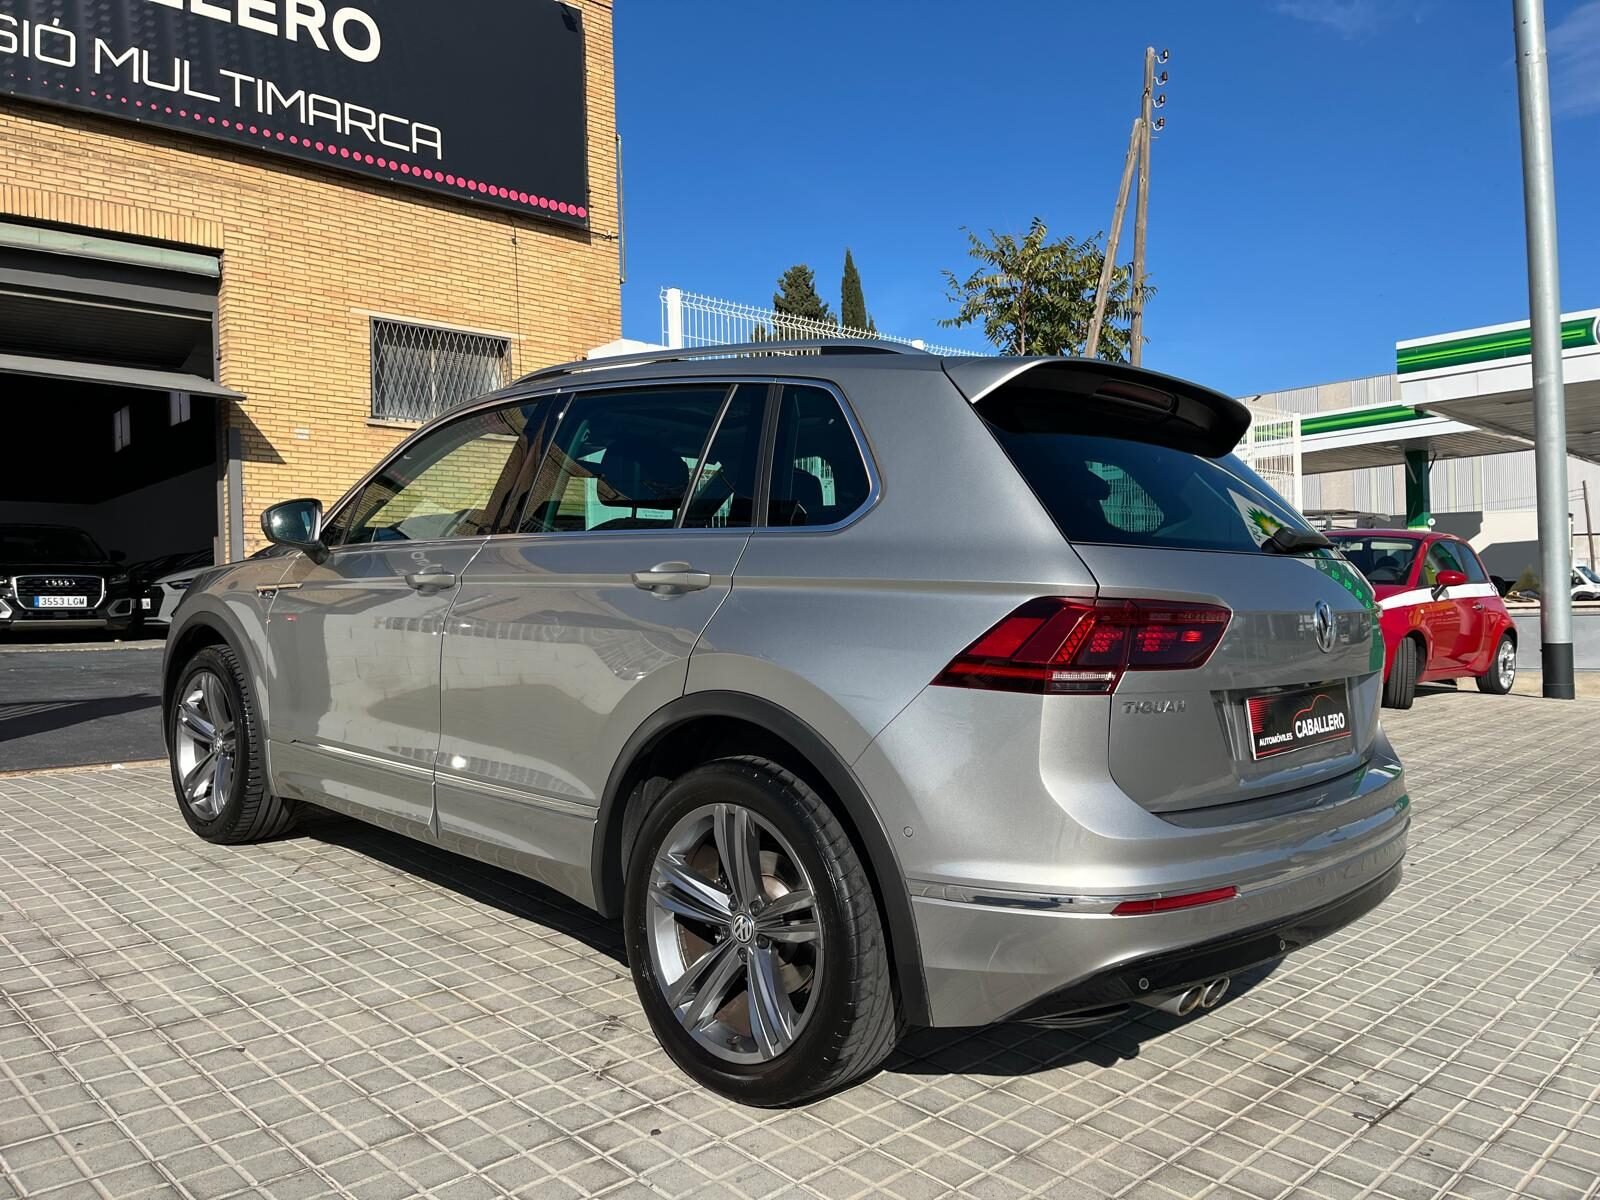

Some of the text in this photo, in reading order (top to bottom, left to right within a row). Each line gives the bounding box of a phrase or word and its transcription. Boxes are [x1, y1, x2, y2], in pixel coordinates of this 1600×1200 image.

[94, 37, 443, 161] MULTIMARCA
[41, 597, 65, 606] 3553
[1259, 712, 1345, 747] AUTOMÓVILES CABALLERO
